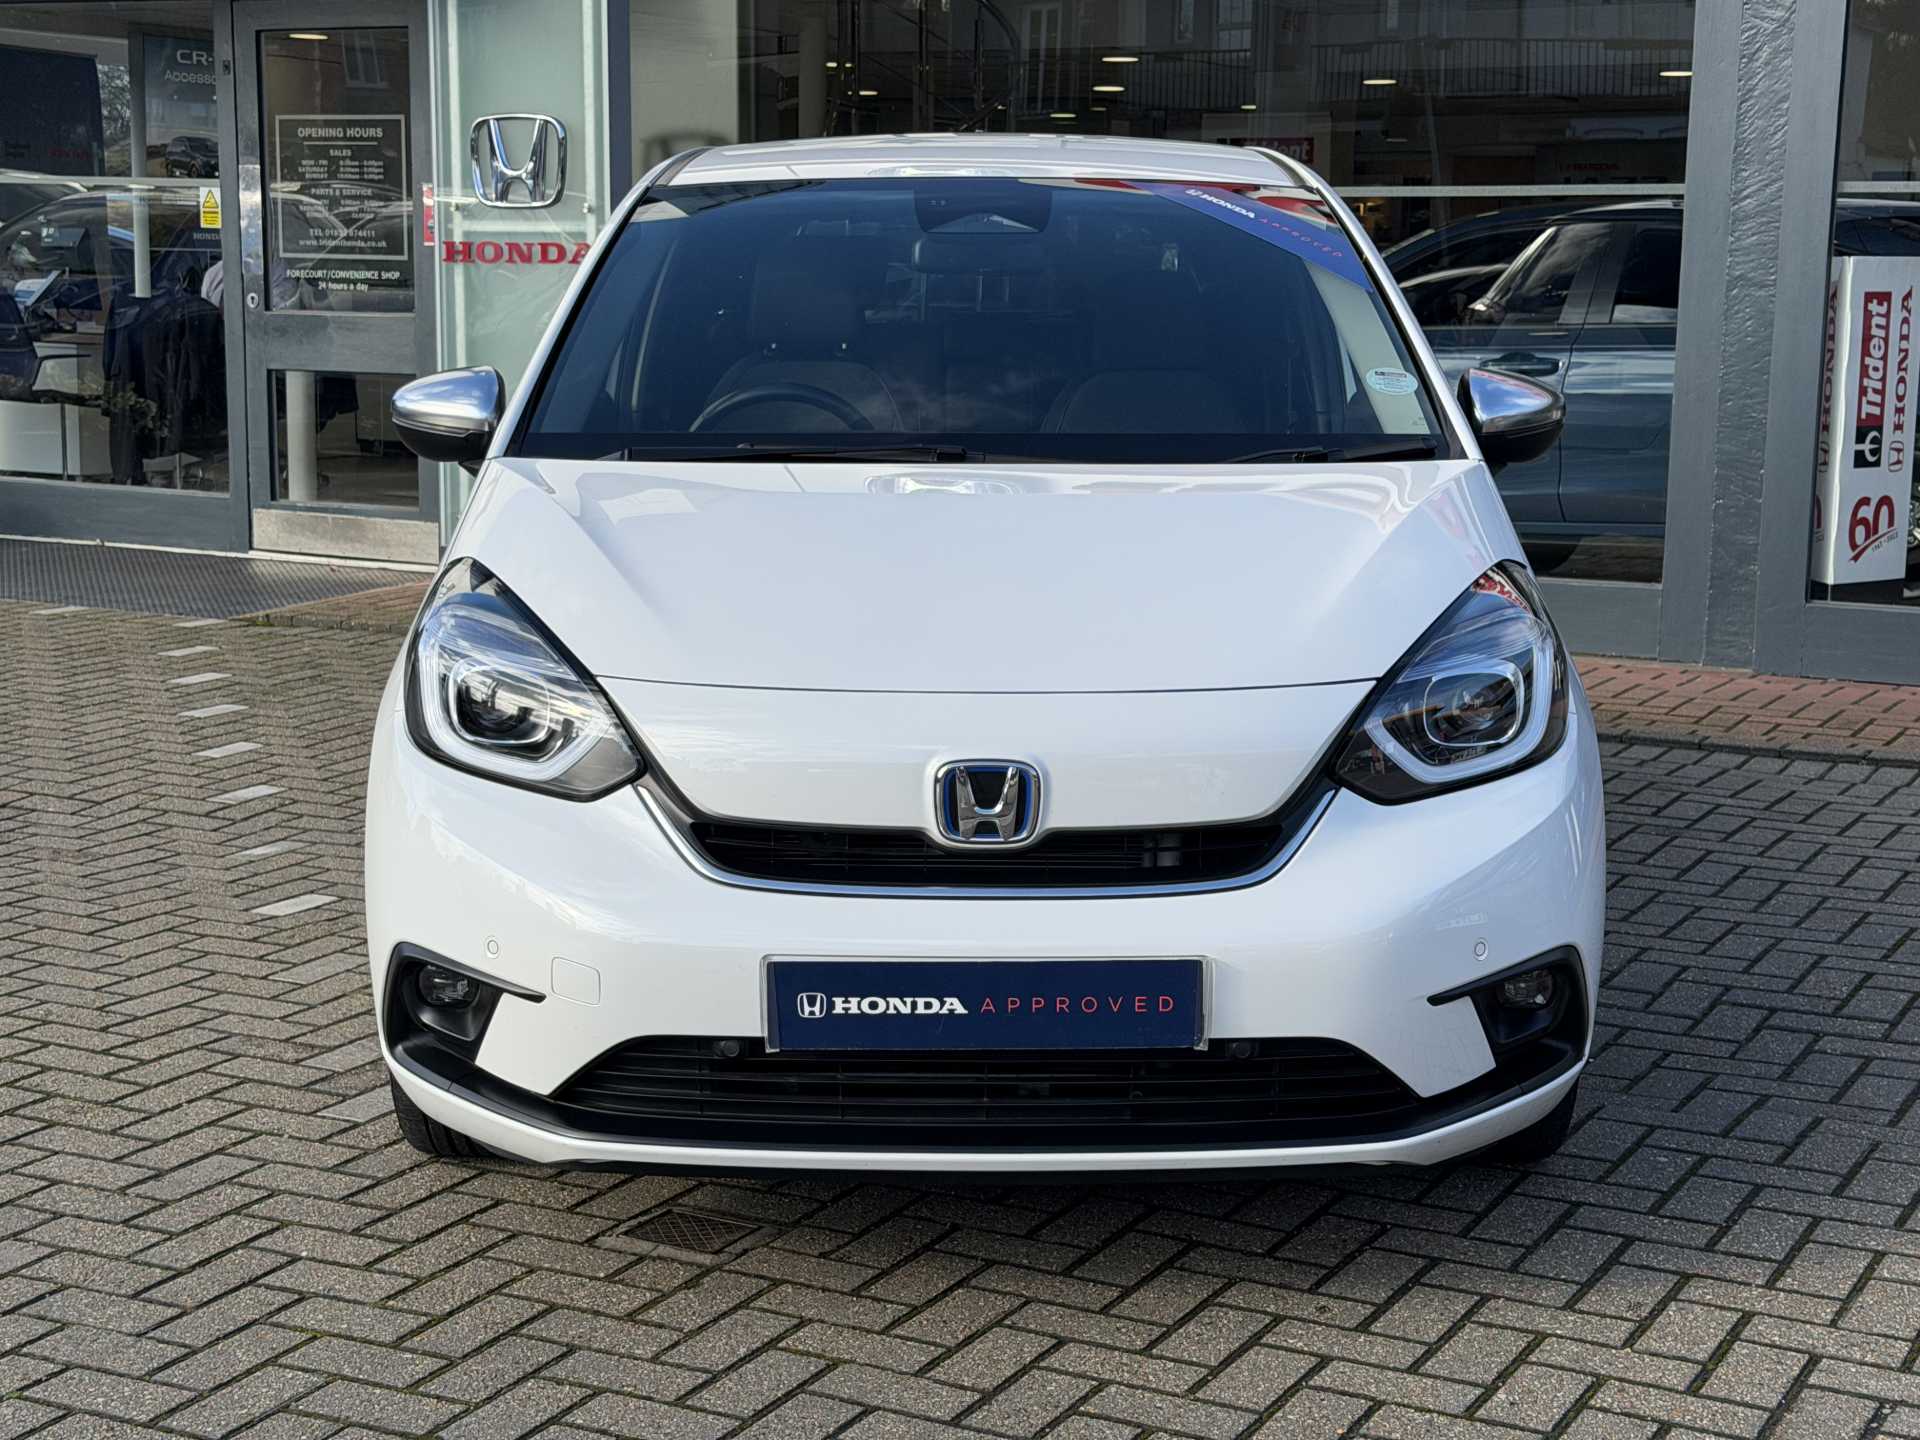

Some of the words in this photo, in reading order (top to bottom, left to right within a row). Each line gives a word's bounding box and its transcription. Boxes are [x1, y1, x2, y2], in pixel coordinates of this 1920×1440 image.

[297, 127, 344, 138] OPENING
[346, 128, 384, 138] HOURS
[329, 149, 352, 157] SALES
[311, 188, 334, 196] PARTS
[1201, 192, 1256, 220] HONDA
[309, 228, 323, 237] TEL
[381, 270, 401, 280] SHOP
[318, 281, 327, 290] 24
[328, 281, 348, 290] hours
[356, 282, 369, 293] day
[1861, 297, 1888, 421] Trident
[1892, 285, 1914, 435] HONDA
[831, 997, 969, 1015] HONDA
[980, 995, 1175, 1014] APPROVED
